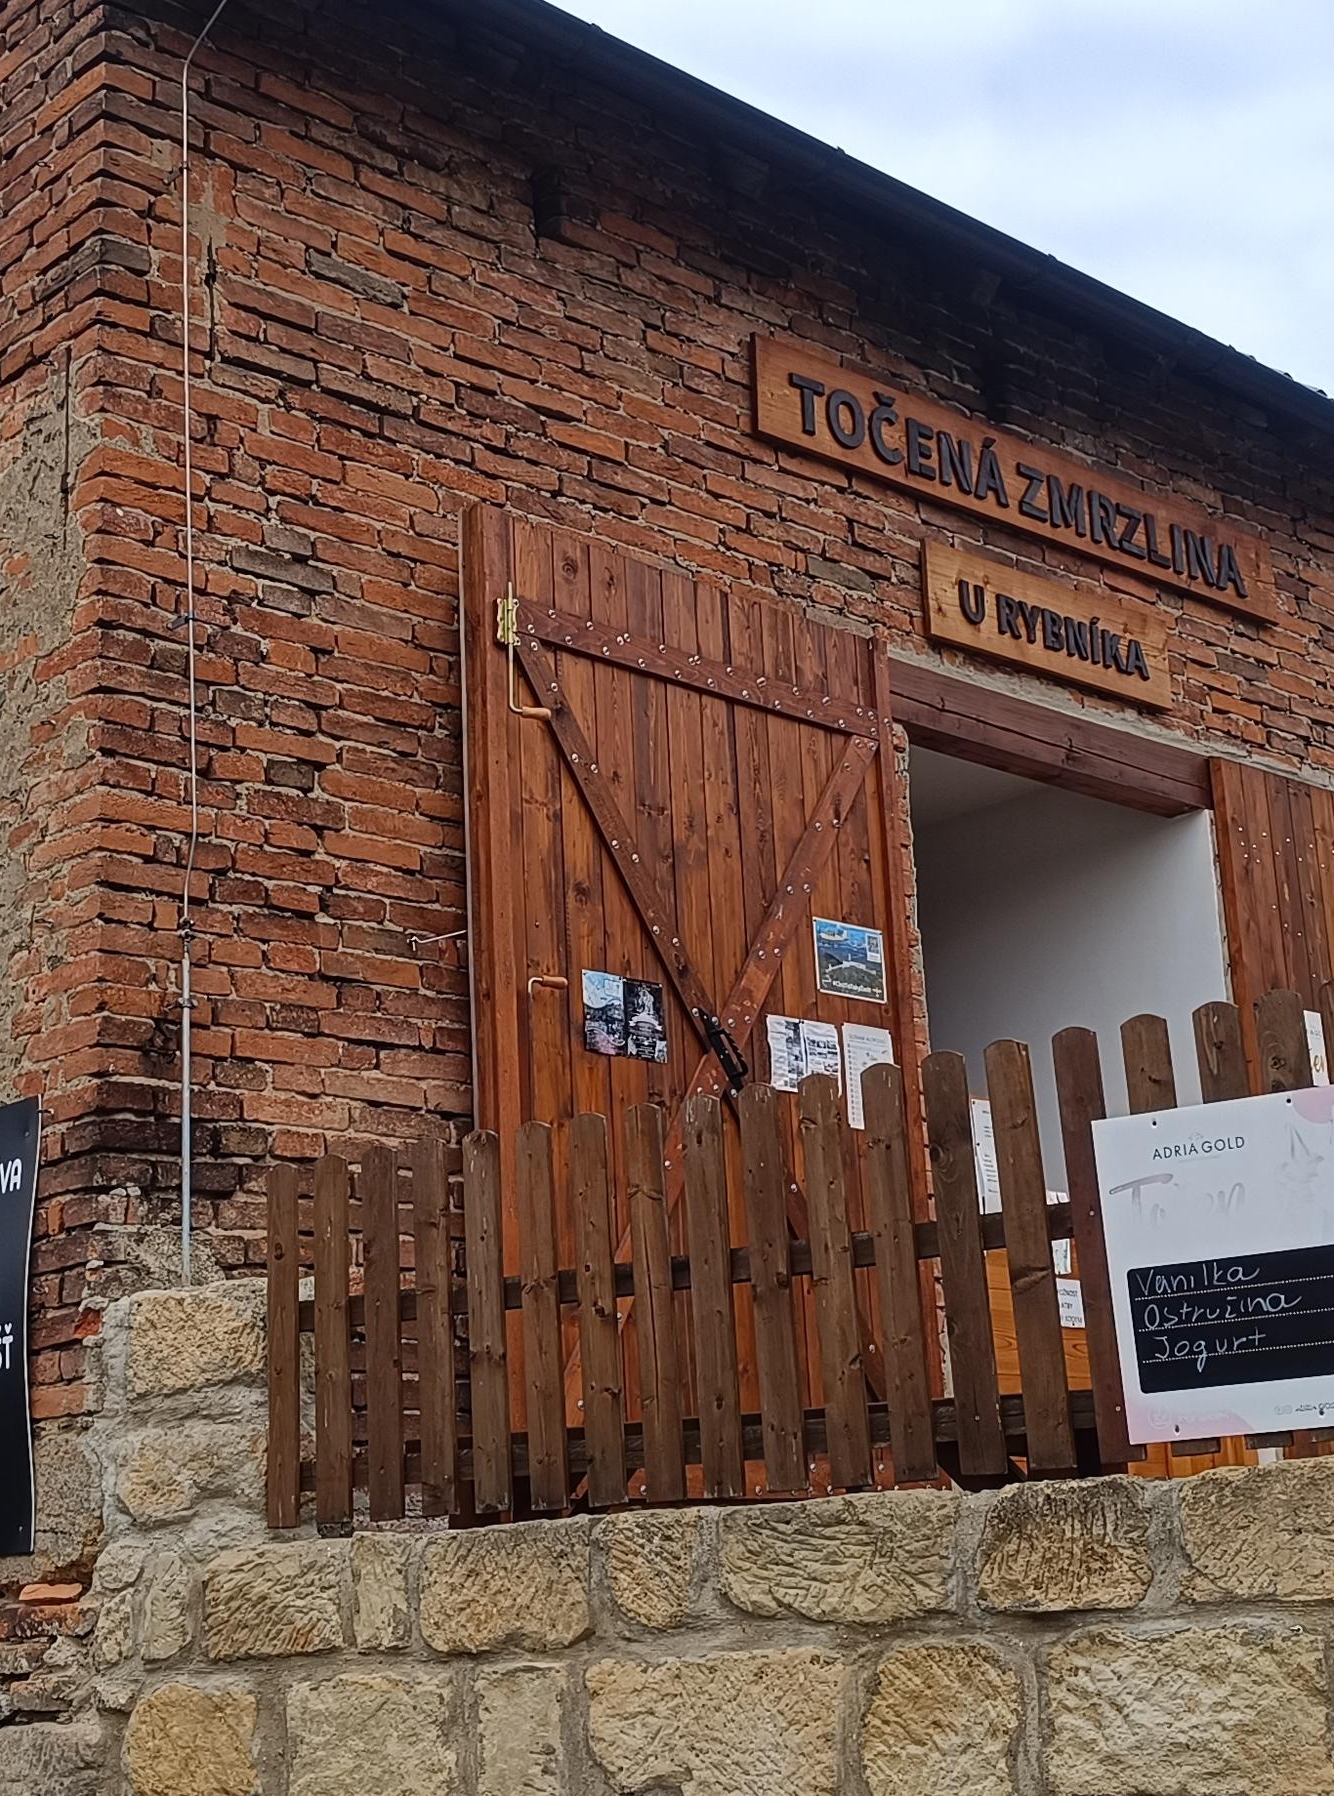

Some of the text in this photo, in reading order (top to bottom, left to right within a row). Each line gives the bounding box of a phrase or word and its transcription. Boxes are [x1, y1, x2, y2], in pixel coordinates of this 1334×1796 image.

[789, 372, 1248, 598] TOČENÁ ZMRZLINA
[958, 579, 1151, 680] U RYBNÍKA
[1152, 1143, 1199, 1161] ADRIA
[1201, 1136, 1245, 1154] GOLD
[1136, 1262, 1260, 1296] Vanilka
[1144, 1292, 1302, 1329] Ostružina
[1154, 1326, 1267, 1373] Jogurt
